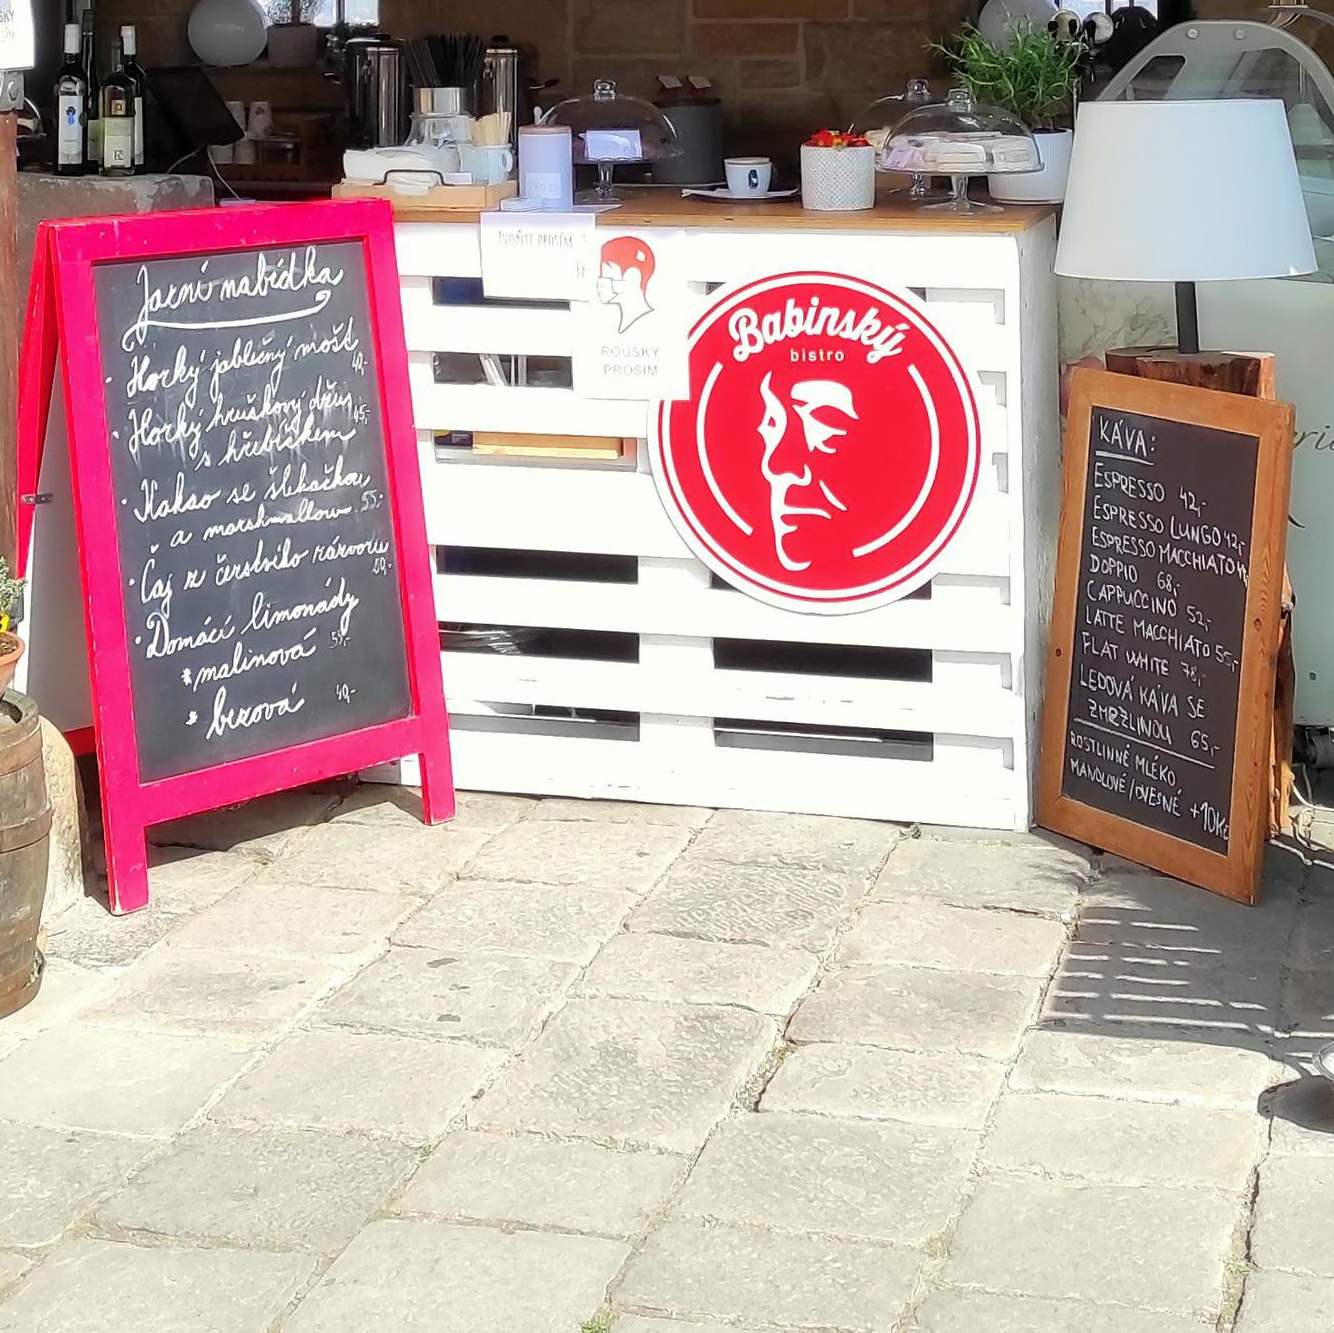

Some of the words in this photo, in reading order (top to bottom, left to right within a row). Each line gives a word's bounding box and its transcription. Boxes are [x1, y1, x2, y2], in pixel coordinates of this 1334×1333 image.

[136, 260, 212, 345] Jarní
[220, 246, 344, 301] nabídka
[728, 297, 911, 364] Babinský
[790, 350, 844, 362] bistro
[127, 345, 204, 409] Horký
[210, 336, 294, 403] jablečný
[294, 317, 359, 360] mošt
[127, 402, 204, 459] Horký
[205, 384, 306, 432] hruškový
[309, 375, 353, 412] džus
[1099, 415, 1157, 457] KÁVA:
[194, 449, 212, 471] s
[1094, 462, 1166, 503] ESPRESSO
[134, 471, 222, 523] Kakao
[226, 484, 256, 504] se
[1093, 495, 1164, 534] ESPRESSO
[1170, 516, 1221, 547] LUNGO
[170, 529, 193, 548] a
[1092, 526, 1156, 558] ESPRESSO
[1158, 543, 1236, 577] MACCHIATO
[140, 542, 174, 617] Čaj
[1089, 554, 1138, 583] DOPPIO
[1157, 571, 1181, 597] 68,-
[146, 612, 235, 659] Domácí
[240, 576, 359, 636] limonády
[1085, 606, 1125, 634] LATTE
[1133, 619, 1211, 658] MACCHIATO
[1087, 580, 1177, 618] CAPPUCCINO
[1186, 605, 1212, 633] 52,-
[193, 628, 318, 692] malinová
[1082, 631, 1120, 661] FLAT
[1126, 650, 1170, 677] WHITE
[205, 682, 306, 741] bezová
[1079, 664, 1134, 702] LEDOVÁ
[1140, 684, 1180, 717] KÁVA
[1187, 695, 1206, 719] SE
[1070, 731, 1130, 768] ROSTLINNÉ
[1087, 698, 1173, 746] ZMRZLINOU
[1190, 730, 1221, 757] 65,-
